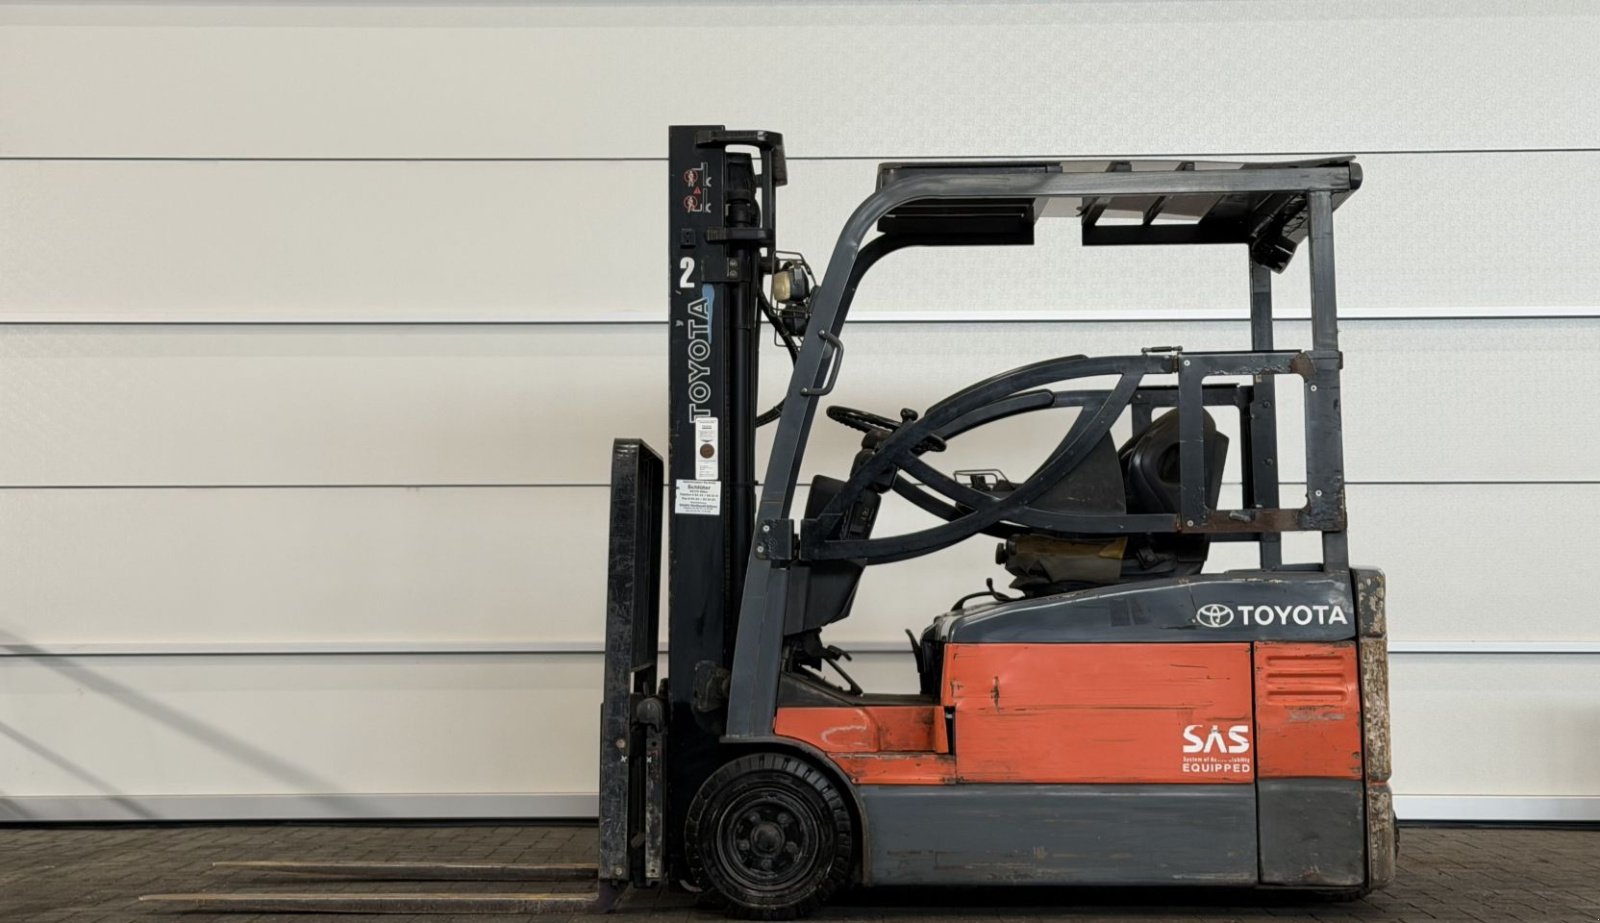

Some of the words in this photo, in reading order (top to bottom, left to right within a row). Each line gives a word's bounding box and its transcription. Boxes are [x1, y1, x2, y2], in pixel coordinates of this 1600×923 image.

[679, 256, 695, 288] 2
[688, 297, 711, 423] TOYOTA
[1237, 605, 1348, 625] TOYOTA
[1183, 725, 1250, 753] SAS
[1183, 763, 1250, 772] EQUIPPED
